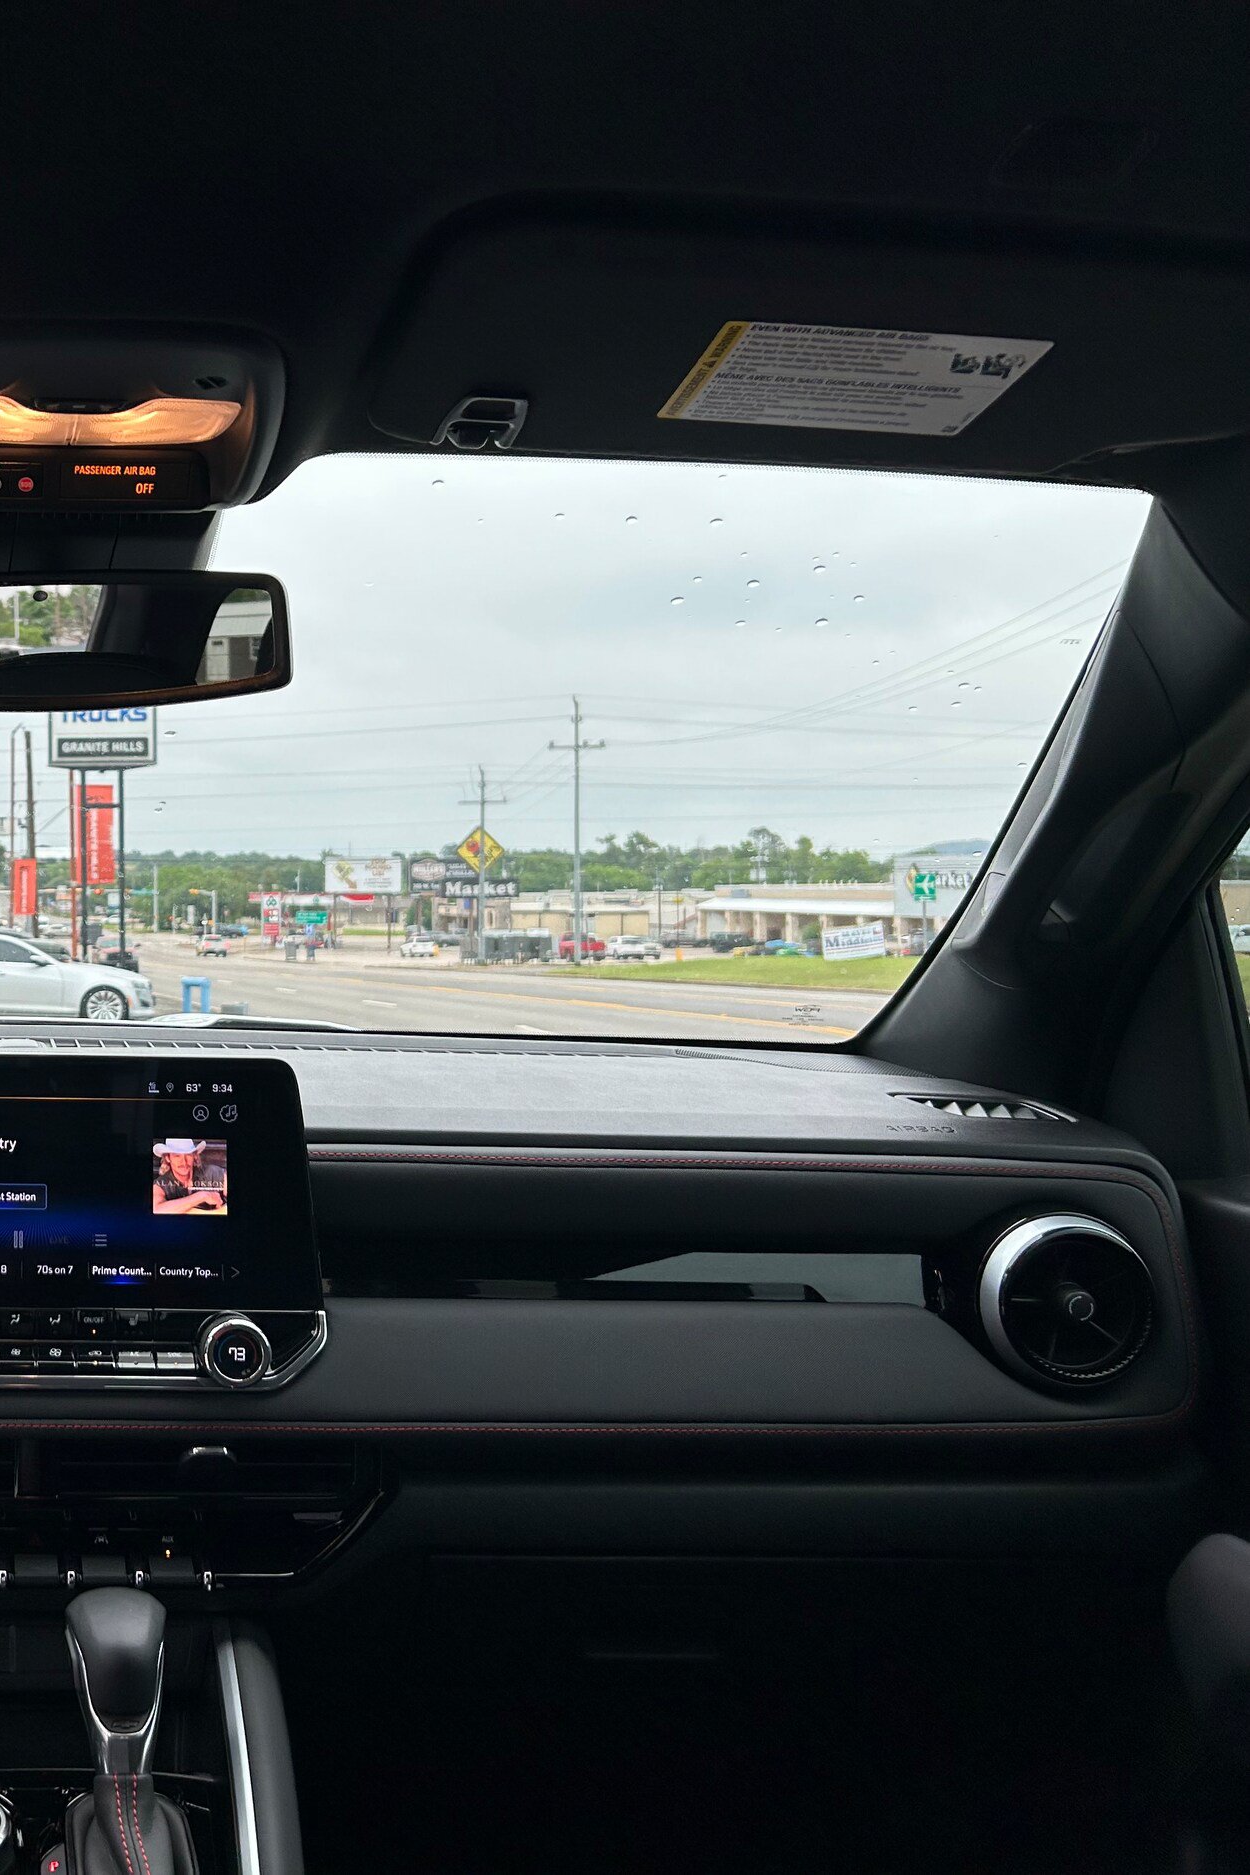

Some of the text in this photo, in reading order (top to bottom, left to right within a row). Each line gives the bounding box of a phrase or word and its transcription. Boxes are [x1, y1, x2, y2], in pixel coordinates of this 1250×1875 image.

[74, 465, 156, 476] PASSENGER AIR BAG
[136, 483, 154, 494] OFF
[62, 707, 147, 723] TRUCKS
[61, 740, 145, 753] GRANITE HILLS
[445, 880, 517, 897] Market
[212, 1084, 233, 1093] 9:34
[6, 1192, 37, 1201] Station
[0, 1264, 8, 1274] 8
[37, 1265, 74, 1275] 70s on 7
[92, 1265, 117, 1276] Prime
[159, 1266, 194, 1278] Country
[83, 1316, 104, 1324] ON/OFF
[229, 1347, 246, 1361] 73
[161, 1535, 175, 1543] AUX
[49, 1861, 60, 1873] P
